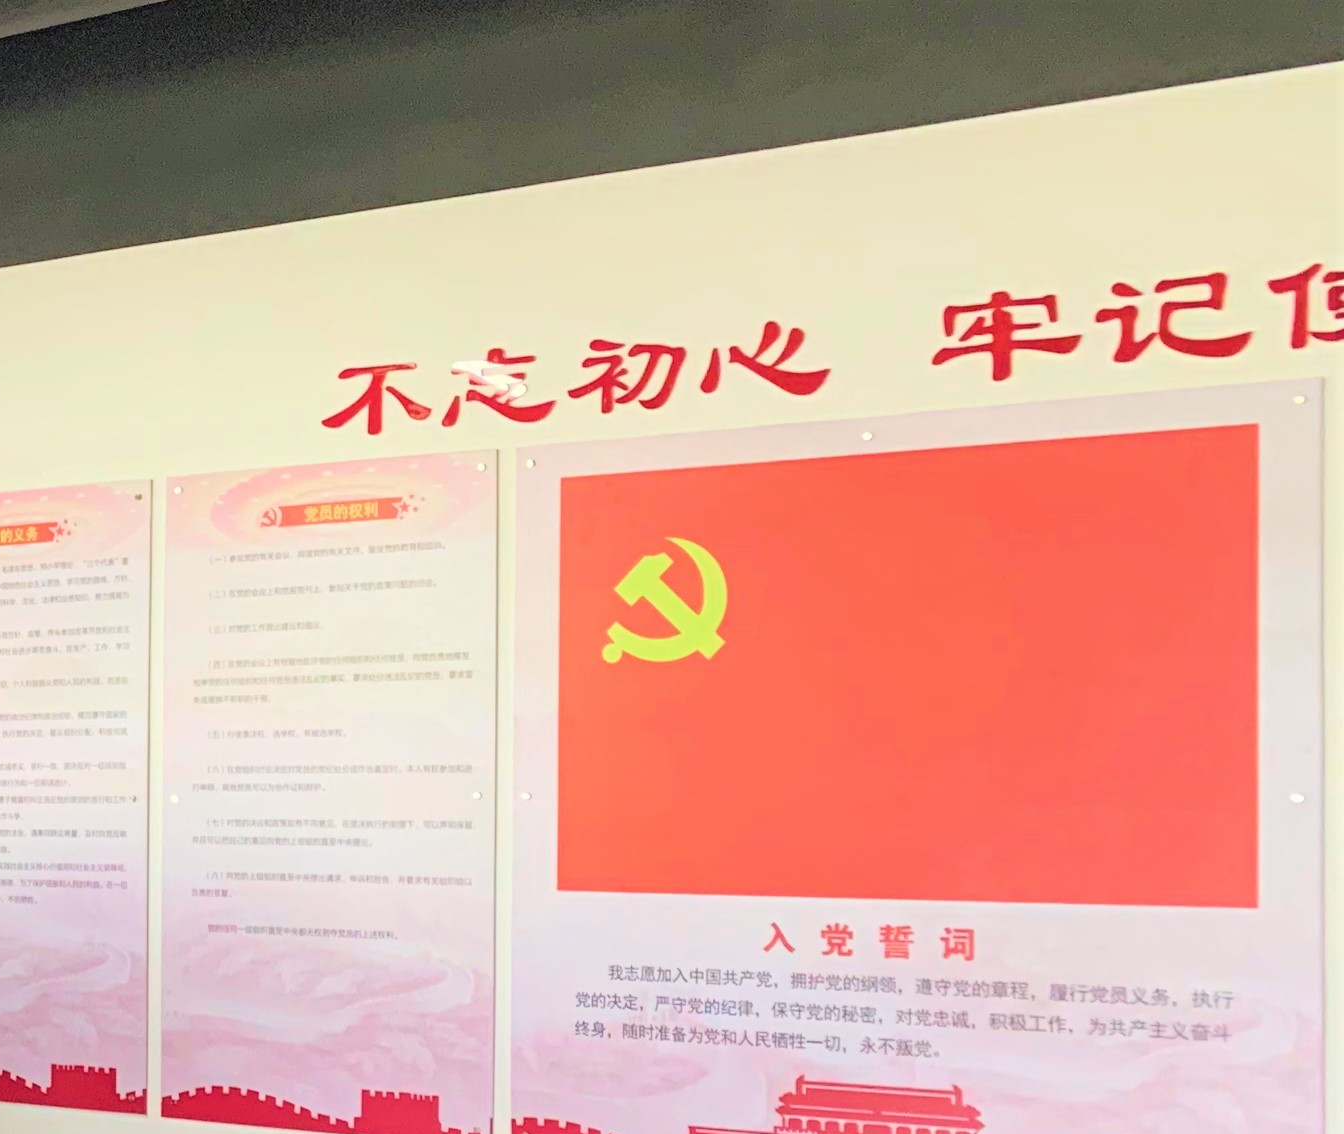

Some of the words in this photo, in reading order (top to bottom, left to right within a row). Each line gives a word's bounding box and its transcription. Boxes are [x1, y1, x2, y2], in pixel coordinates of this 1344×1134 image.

[322, 321, 830, 435] 不忘初心
[303, 501, 379, 523] 党员的权利
[763, 922, 976, 962] 入党誓词
